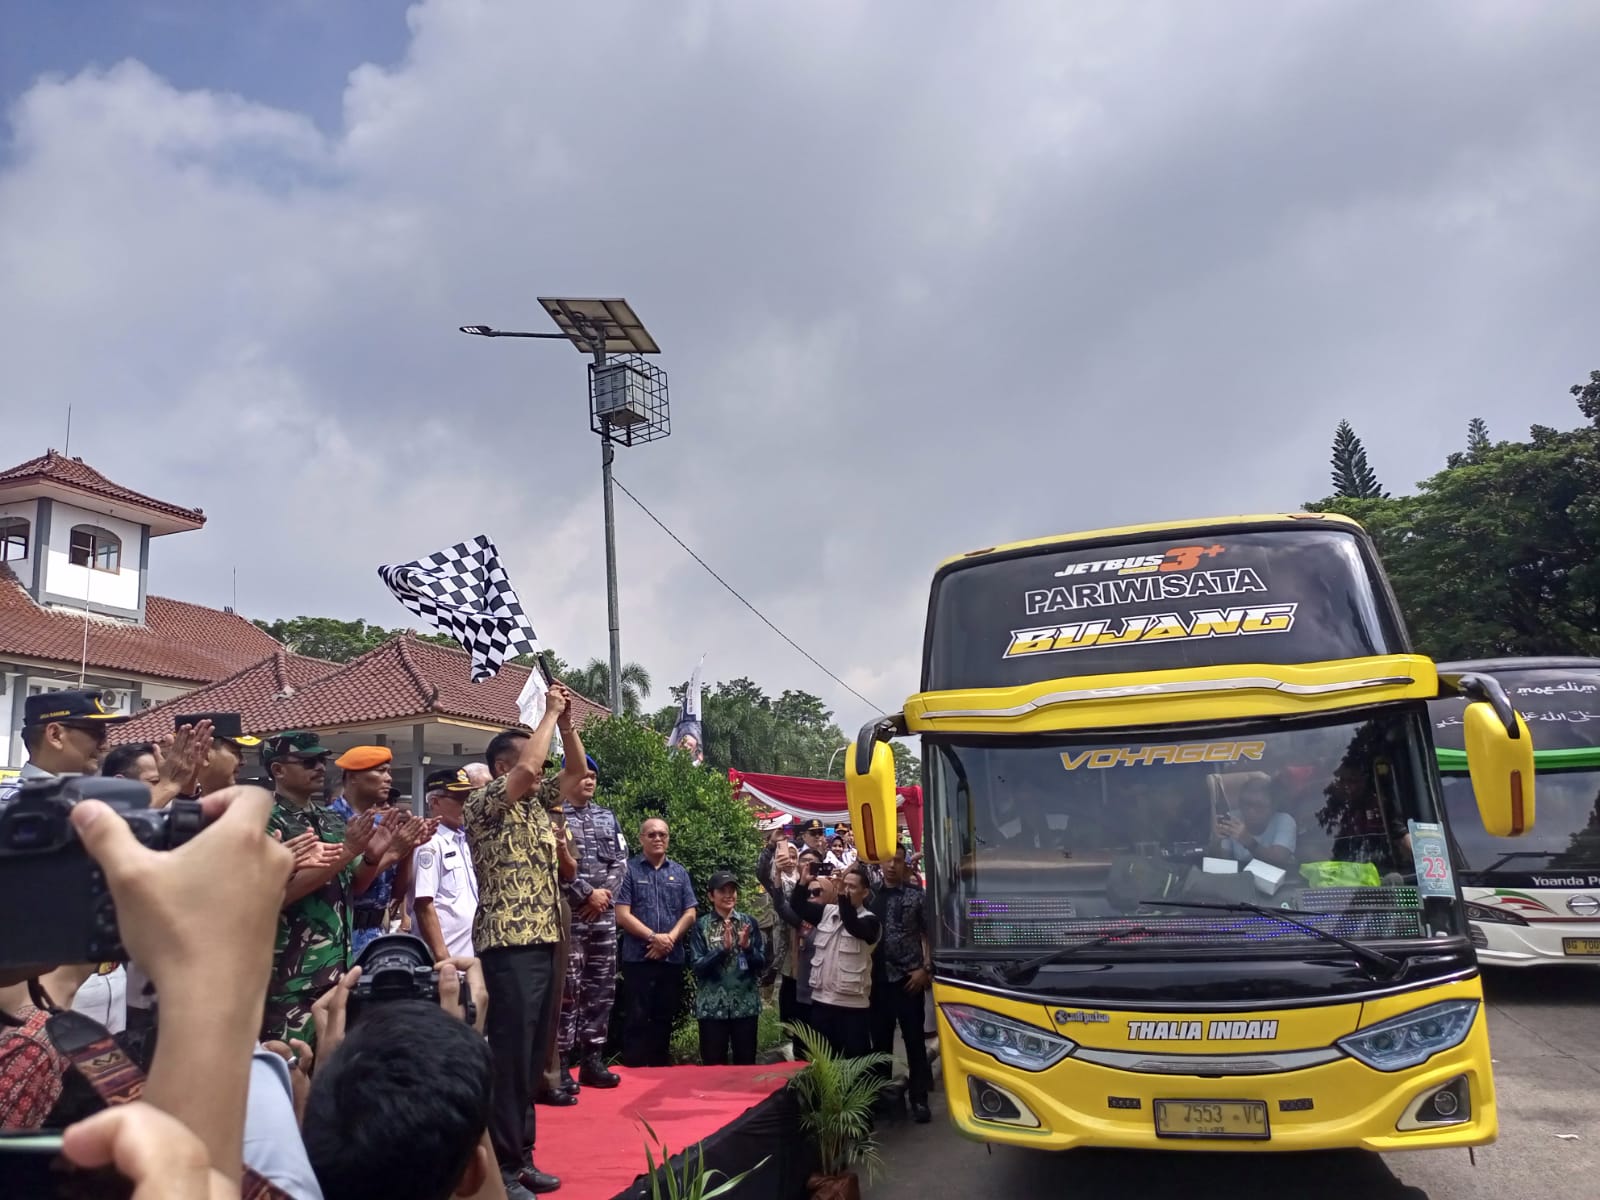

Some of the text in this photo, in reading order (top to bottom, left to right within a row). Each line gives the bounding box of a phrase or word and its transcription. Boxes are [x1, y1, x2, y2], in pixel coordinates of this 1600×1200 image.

[1025, 568, 1268, 615] PARIWISATA
[1002, 603, 1298, 659] BUJANG
[1060, 741, 1266, 771] VOYAGER
[1423, 857, 1448, 879] 23
[1531, 876, 1584, 886] Yoanda
[1128, 1020, 1279, 1040] THALIA INDAH
[1183, 1103, 1223, 1123] 7553
[1243, 1105, 1264, 1125] VC
